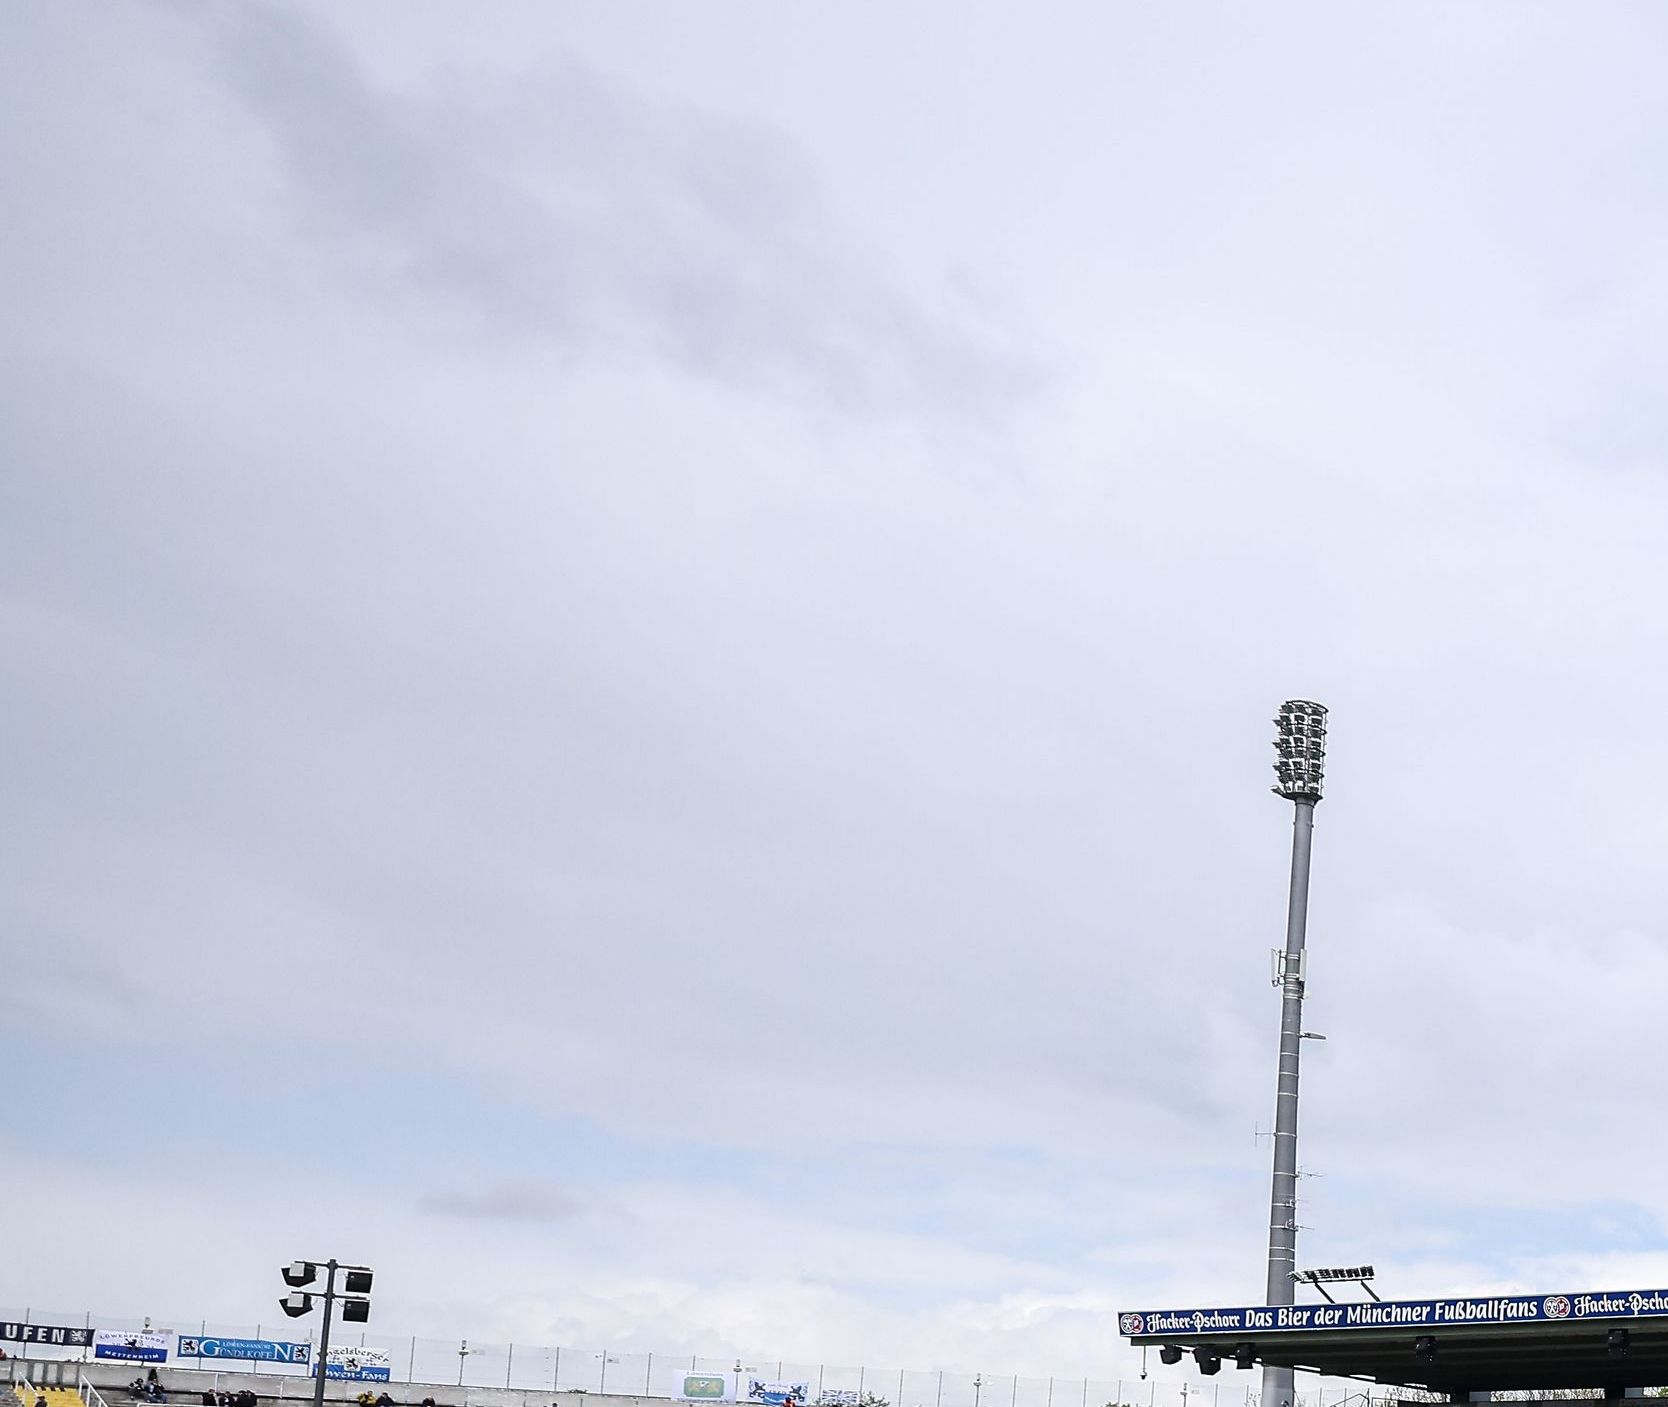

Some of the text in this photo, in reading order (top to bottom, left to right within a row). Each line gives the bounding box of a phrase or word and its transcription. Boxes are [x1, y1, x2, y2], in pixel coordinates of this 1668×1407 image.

[1146, 1300, 1538, 1333] Hacker-Pschorr Das Bier der Münchner Fußballfans
